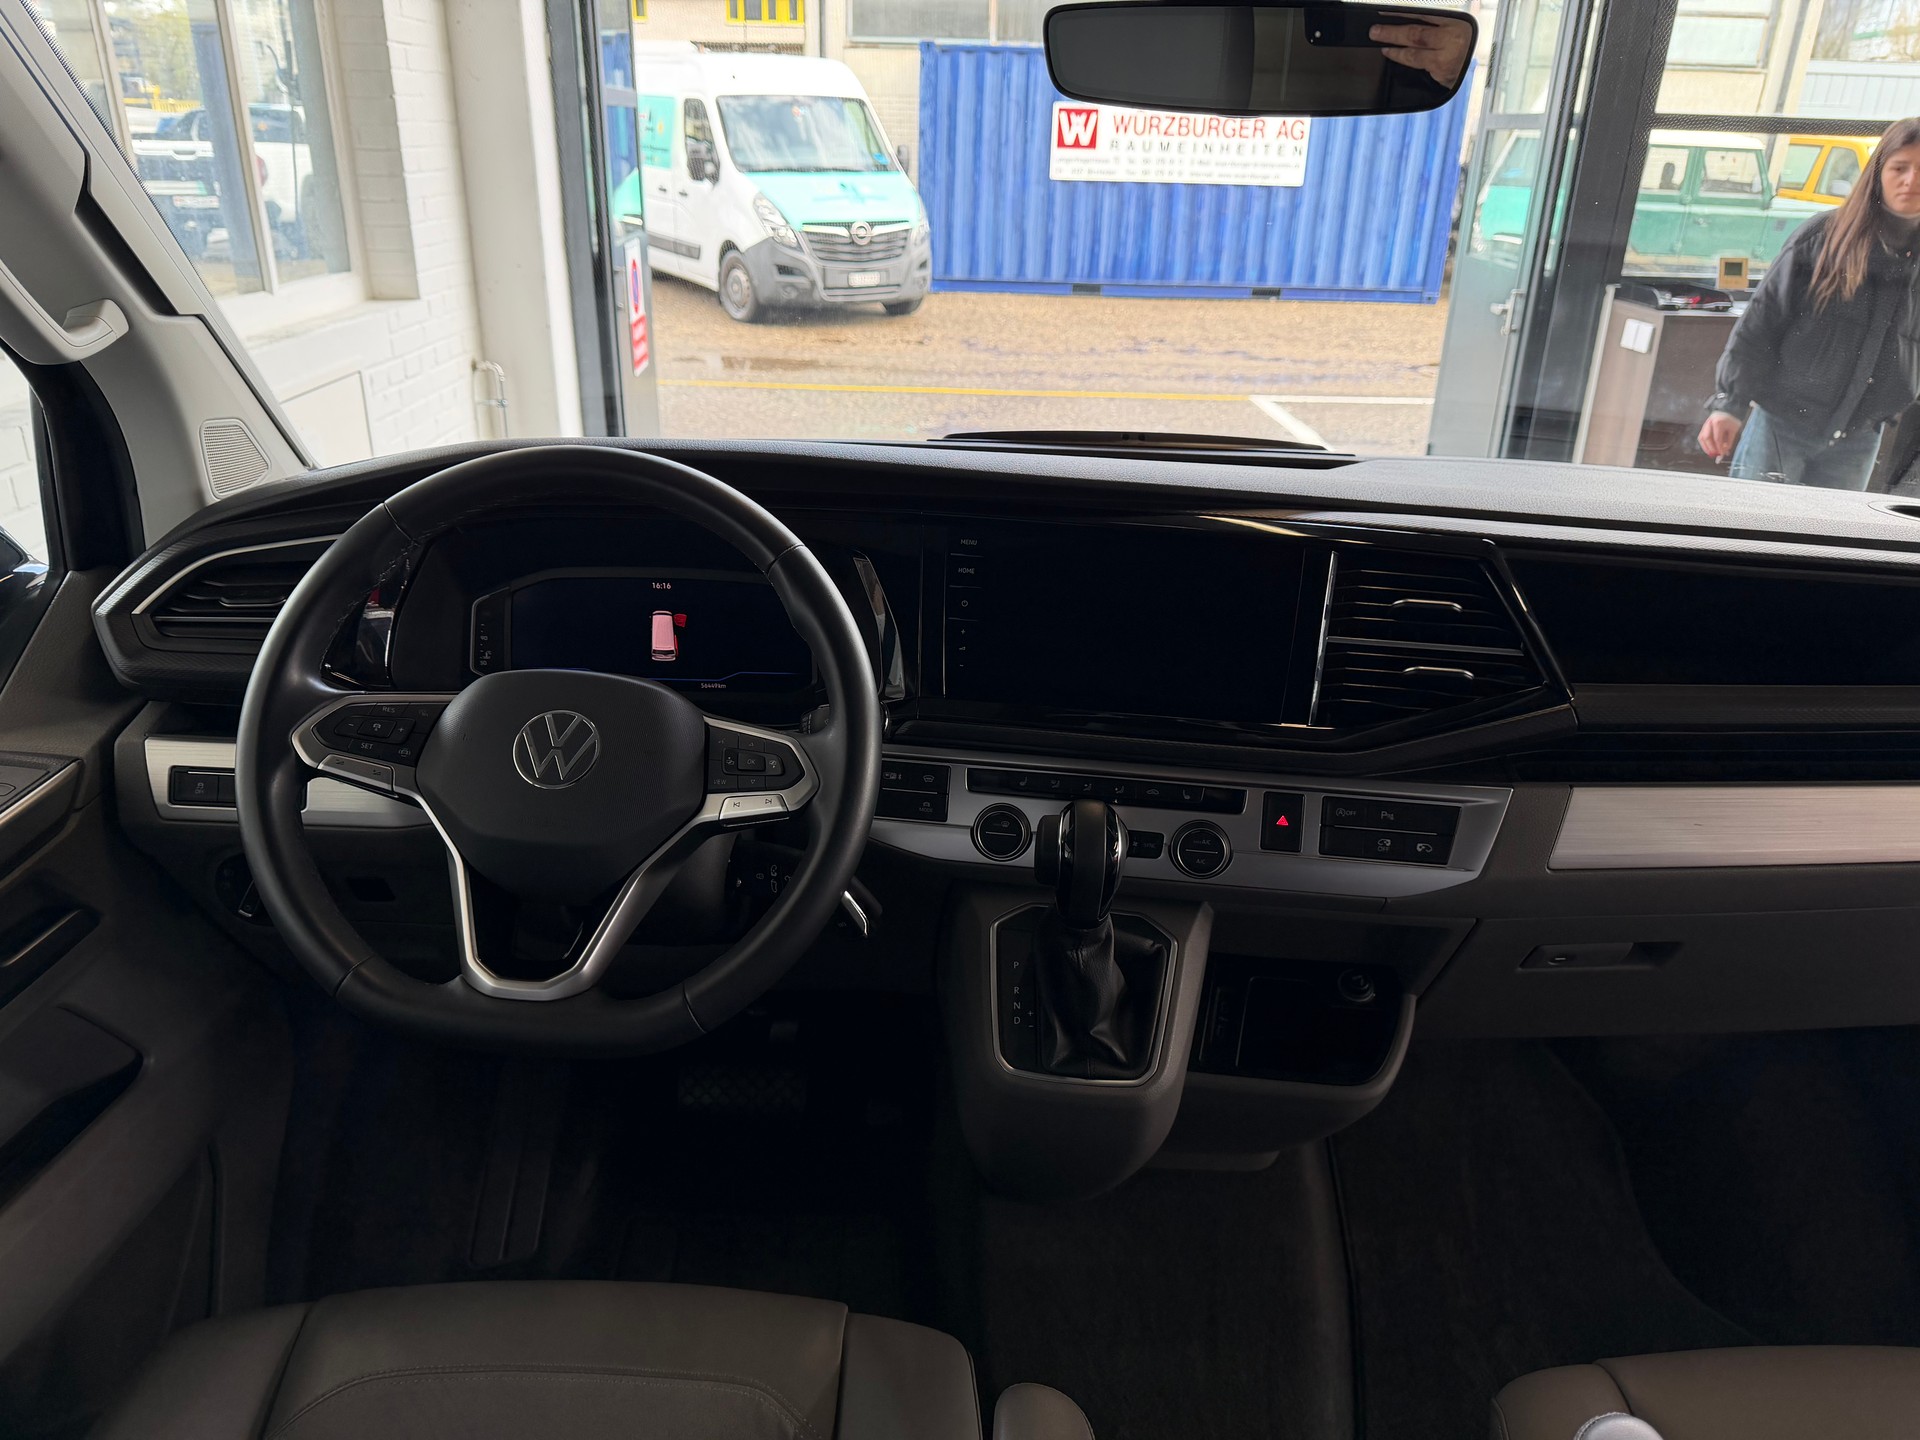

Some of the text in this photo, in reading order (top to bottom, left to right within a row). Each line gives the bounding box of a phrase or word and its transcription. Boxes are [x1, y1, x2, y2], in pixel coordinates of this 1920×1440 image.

[1276, 119, 1305, 141] AG
[1109, 139, 1303, 157] RAUMEINHEITEN
[960, 538, 978, 546] MENU
[958, 567, 975, 575] HOME
[651, 581, 672, 590] 16:16
[382, 705, 396, 714] RES
[360, 742, 374, 750] SET
[746, 758, 756, 766] OK
[1013, 961, 1020, 969] P
[1013, 986, 1021, 994] R
[1013, 1001, 1021, 1010] N
[1013, 1017, 1021, 1025] D
